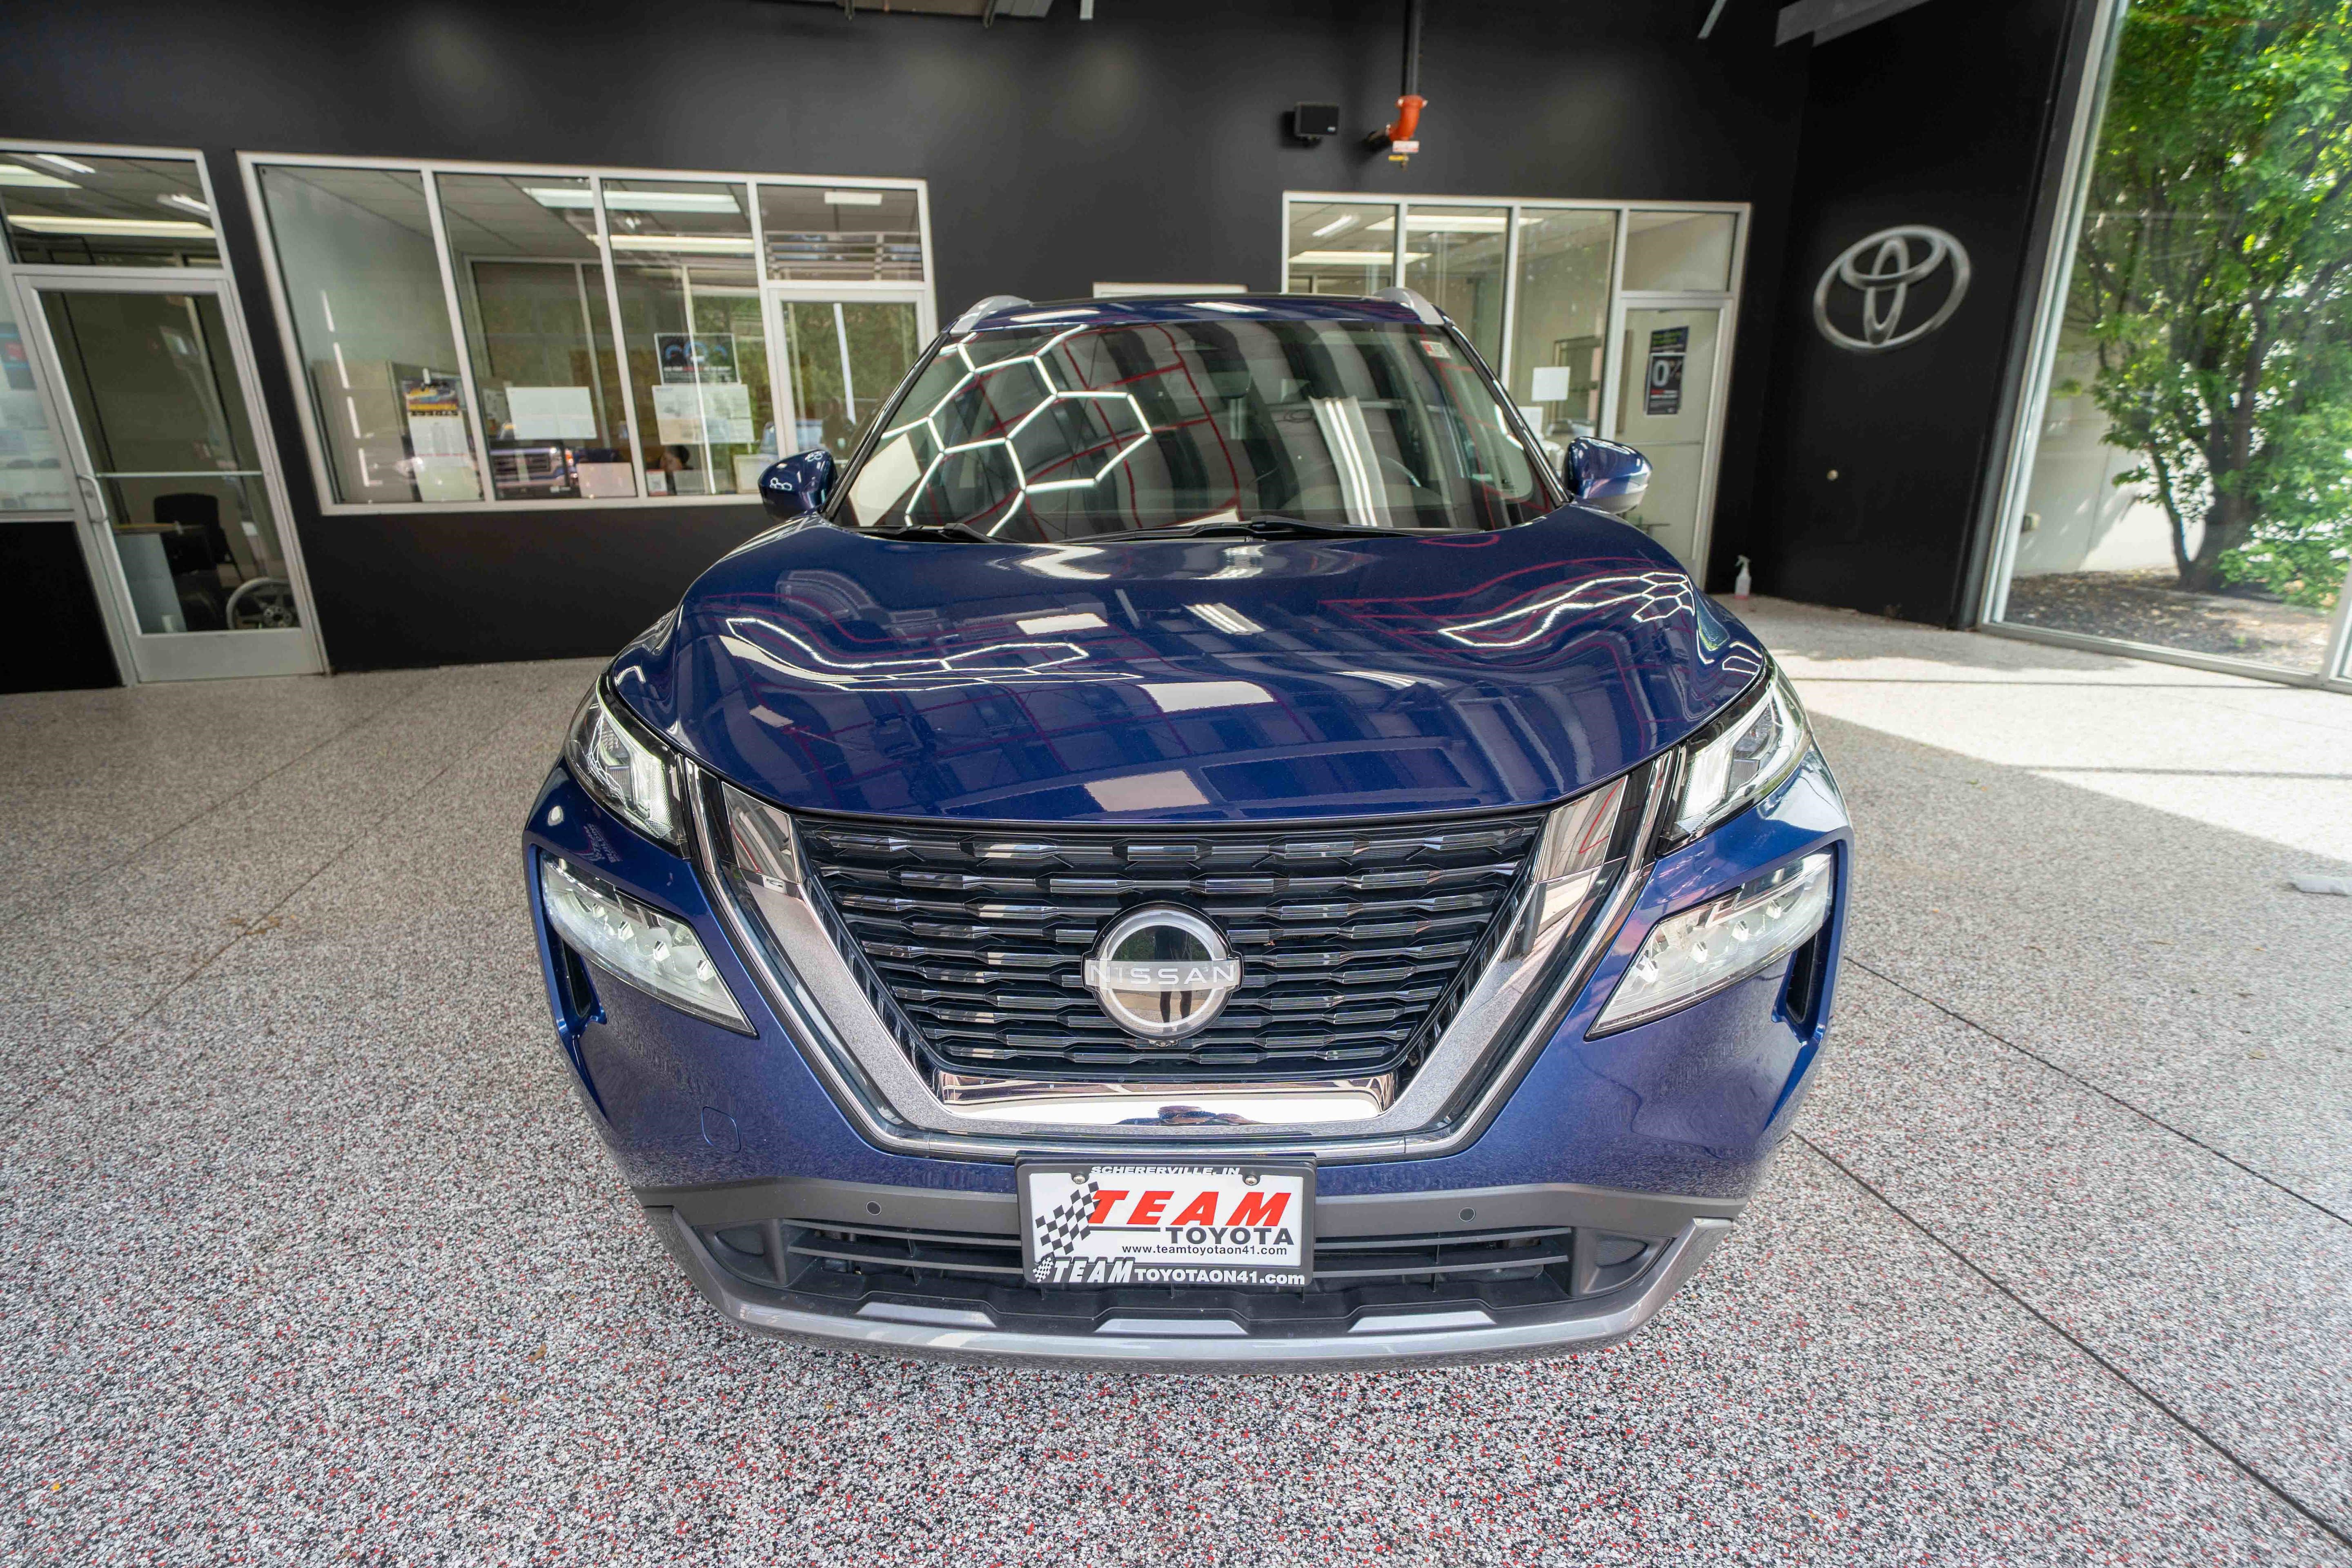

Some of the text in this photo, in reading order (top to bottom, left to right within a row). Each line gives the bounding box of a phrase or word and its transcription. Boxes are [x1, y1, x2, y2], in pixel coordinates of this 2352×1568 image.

[1090, 964, 1235, 985] NISSAN
[1222, 1167, 1241, 1175] IN
[1088, 1190, 1292, 1227] TEAM
[1165, 1227, 1294, 1245] TOYOTA
[1122, 1244, 1287, 1256] www.teamtoyotaon41.com
